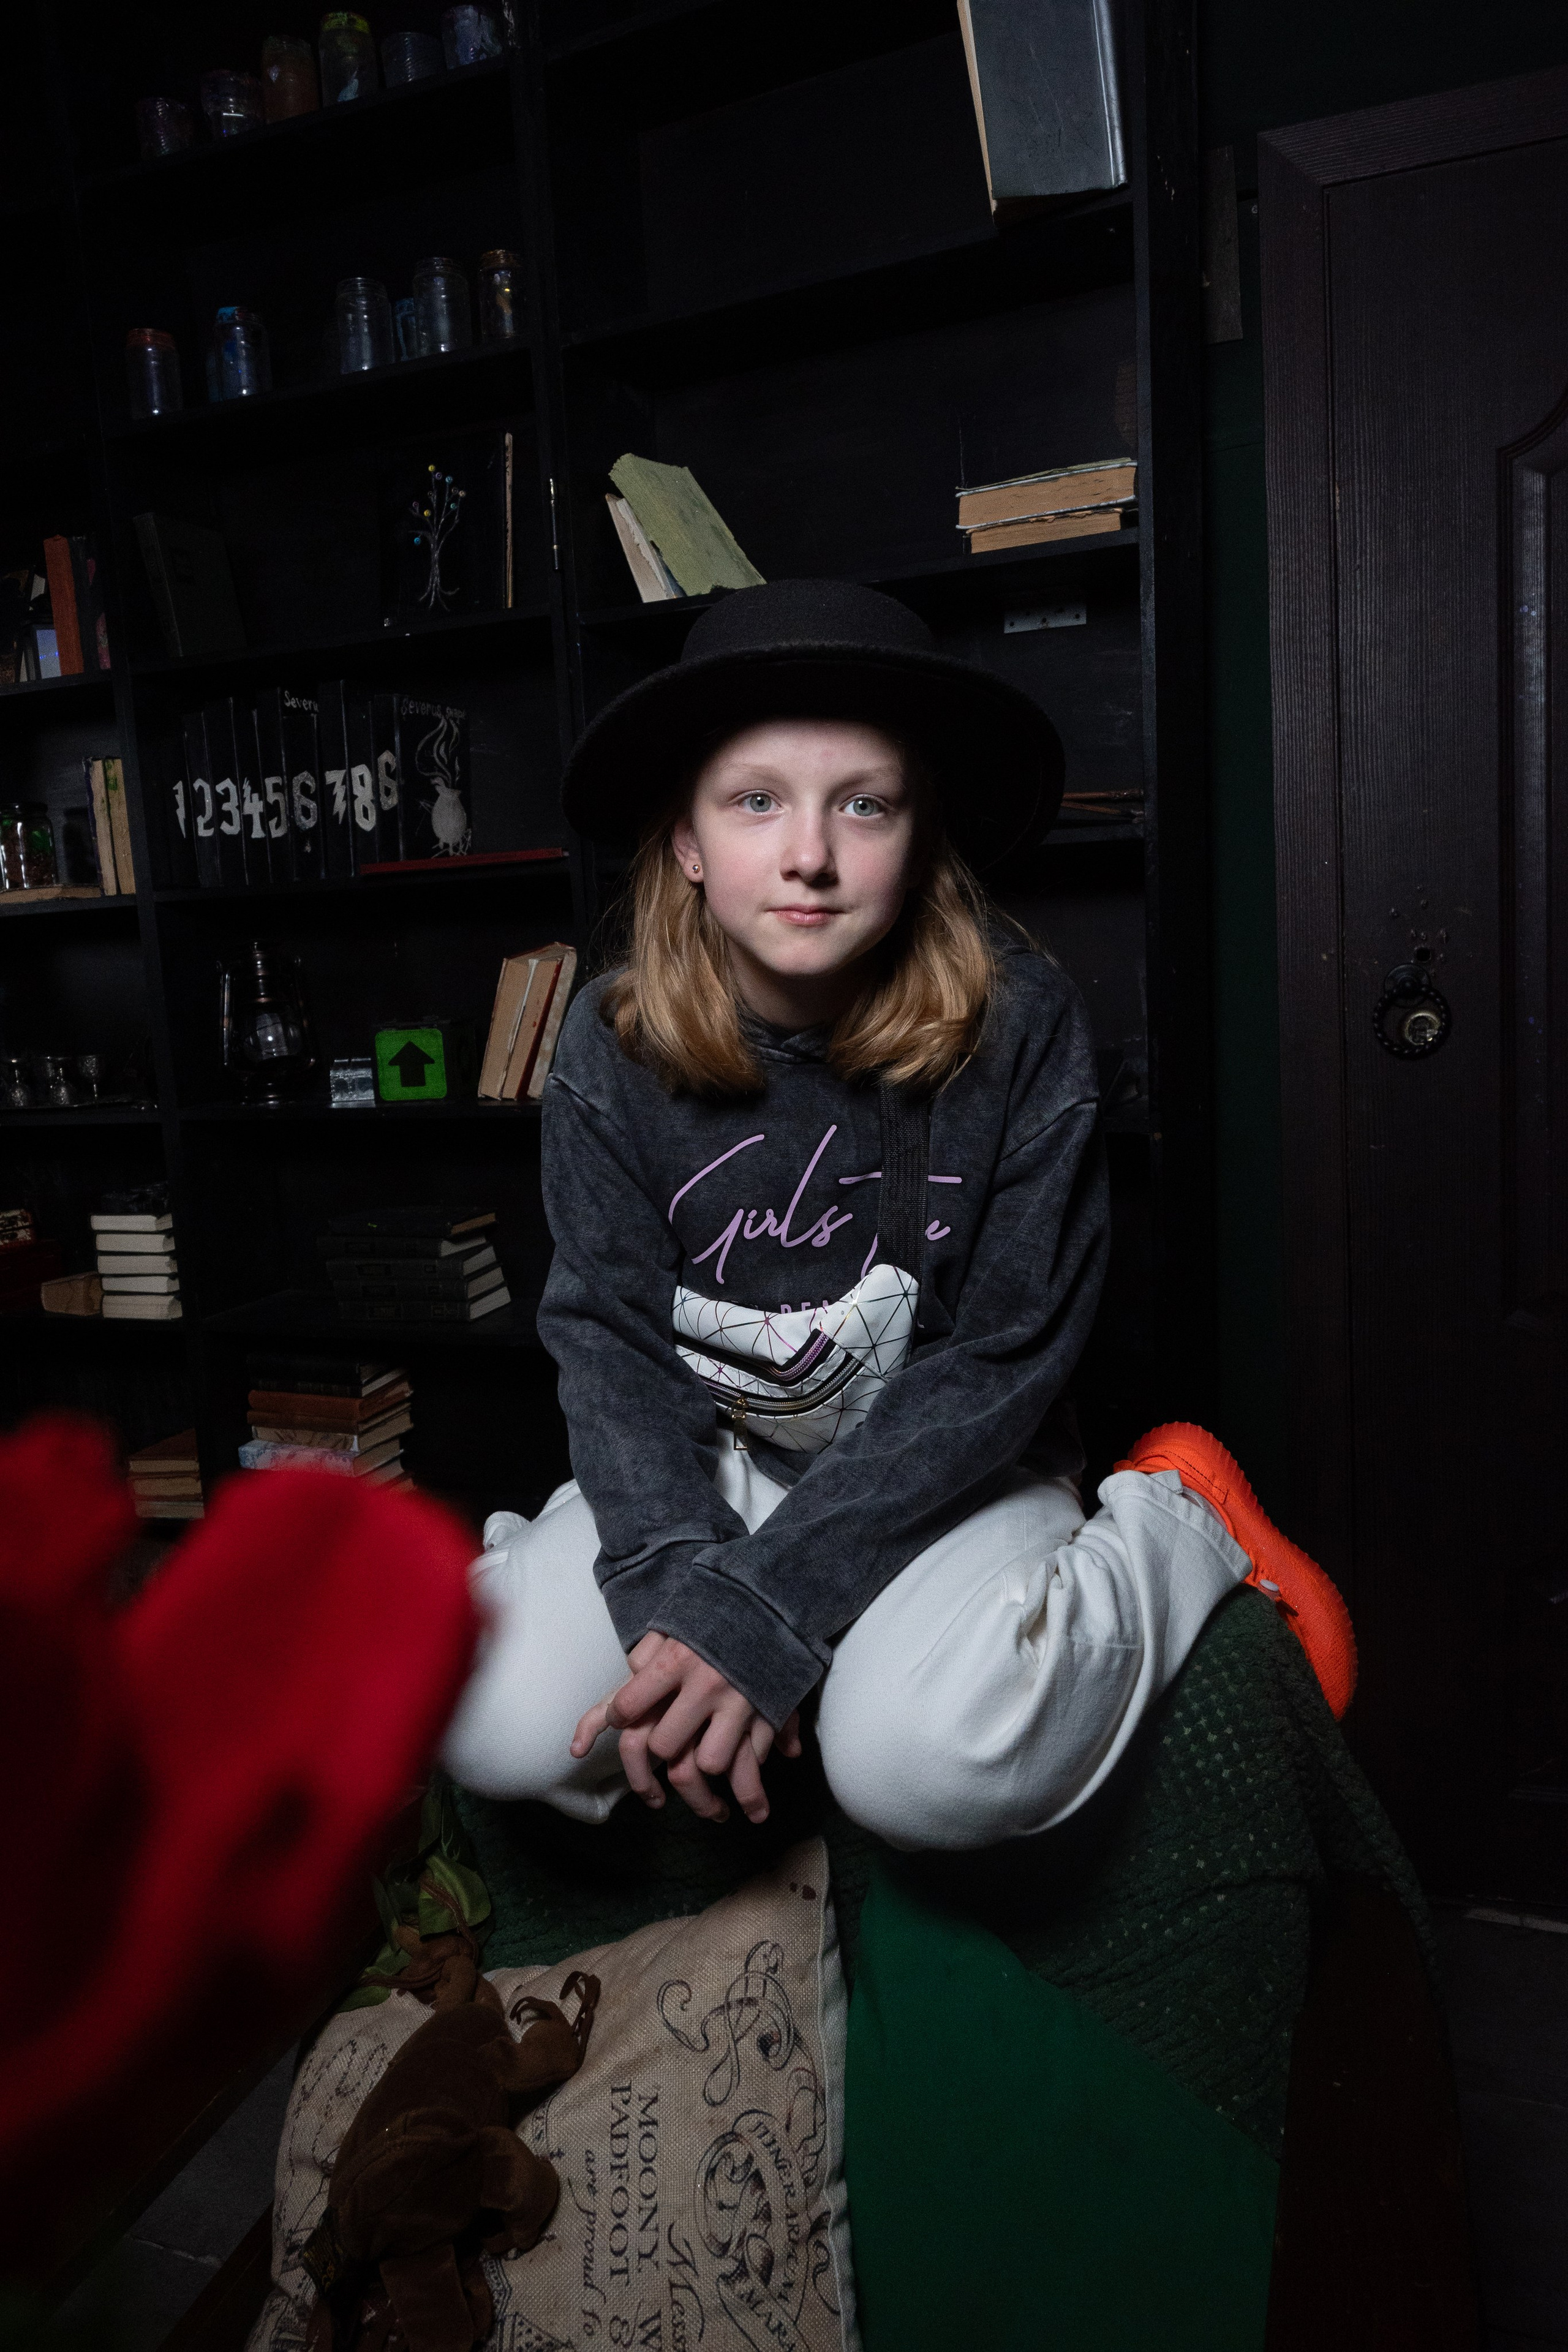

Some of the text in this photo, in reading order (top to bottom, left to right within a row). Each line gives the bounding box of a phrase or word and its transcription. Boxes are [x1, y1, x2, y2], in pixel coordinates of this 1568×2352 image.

[193, 778, 214, 837] 2
[215, 778, 241, 836] 3
[243, 777, 266, 839] 4
[265, 775, 288, 839] 5
[351, 764, 377, 832] 8
[668, 1125, 853, 1284] Girls
[584, 2150, 598, 2196] are
[610, 2081, 631, 2286] PADFOOT
[568, 2177, 606, 2305] proud
